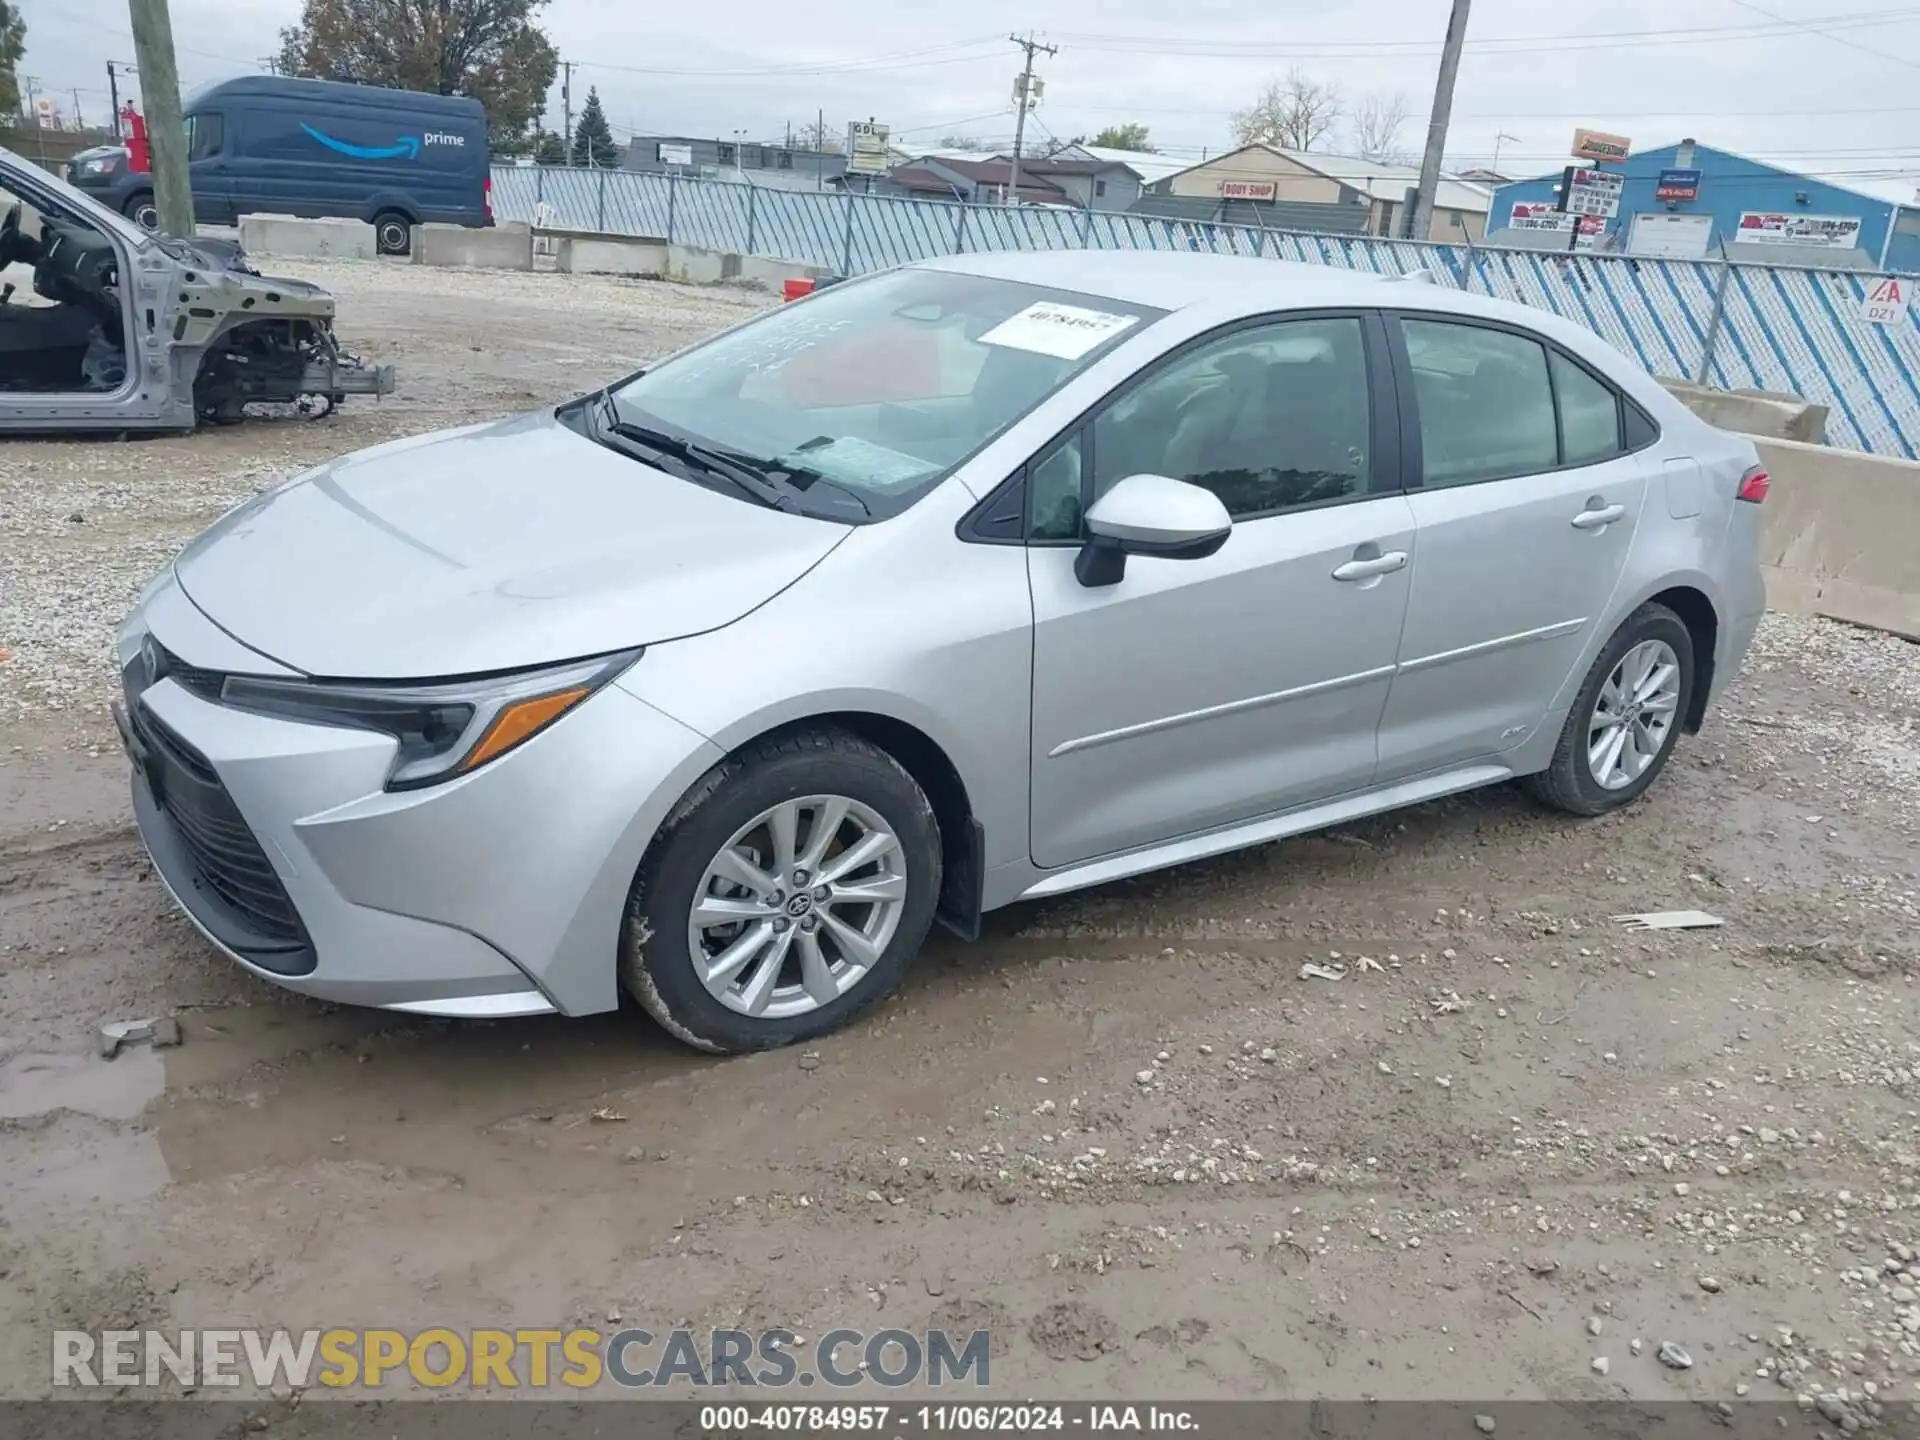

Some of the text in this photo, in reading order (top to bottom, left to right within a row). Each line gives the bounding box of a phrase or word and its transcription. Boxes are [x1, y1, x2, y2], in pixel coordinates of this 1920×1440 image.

[424, 130, 465, 147] prime
[1225, 183, 1272, 196] BODY SHOP
